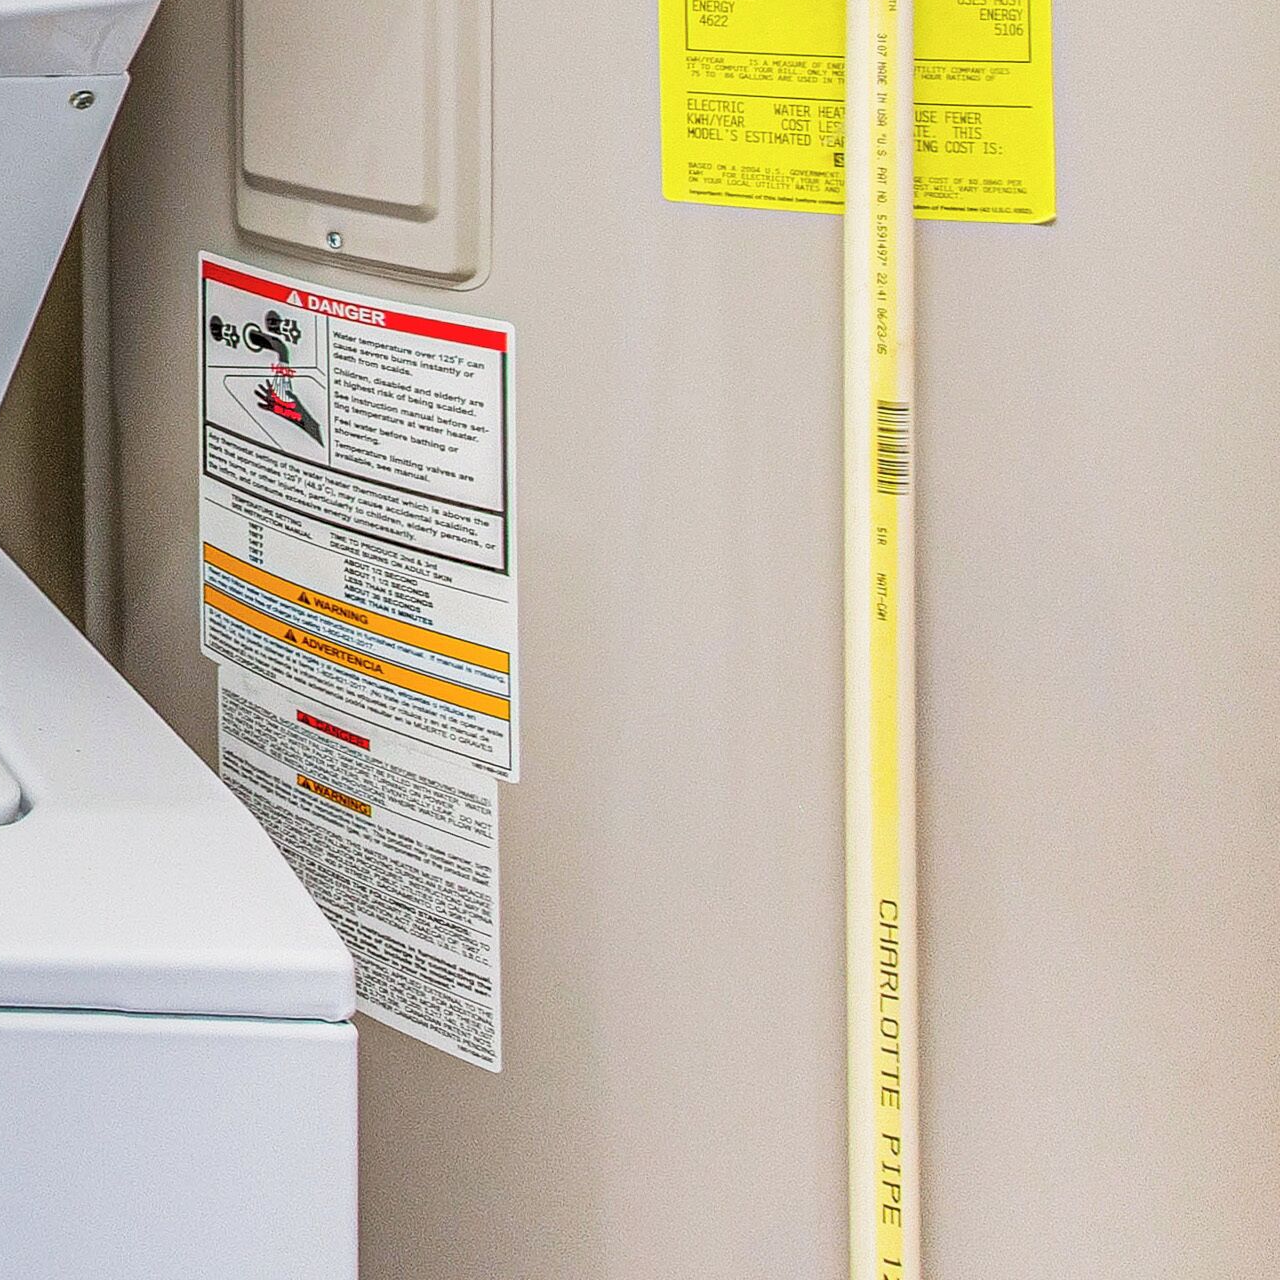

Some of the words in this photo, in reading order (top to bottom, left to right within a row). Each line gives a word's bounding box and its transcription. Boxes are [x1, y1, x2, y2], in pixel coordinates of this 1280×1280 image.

[692, 0, 735, 13] ENERGY
[979, 9, 1024, 21] ENERGY
[699, 15, 729, 28] 4622
[994, 23, 1024, 36] 5106
[687, 98, 745, 114] ELECTRIC
[773, 103, 811, 118] WATER
[944, 112, 983, 125] FEWER
[686, 112, 745, 128] KWH/YEAR
[781, 119, 810, 133] COST
[953, 126, 982, 140] THIS
[687, 127, 738, 142] MODEL'S
[745, 131, 811, 146] ESTIMATED
[945, 141, 977, 154] COST
[983, 142, 1004, 155] IS:
[307, 293, 387, 327] DANGER
[332, 330, 357, 343] Water
[358, 337, 413, 356] temperature
[414, 347, 436, 360] over
[466, 359, 485, 369] can
[313, 596, 369, 625] WARNING
[301, 635, 385, 675] ADVERTENCIA
[313, 782, 370, 815] WARNING
[879, 899, 902, 1110] CHARLOTTE
[881, 1133, 903, 1229] PIPE
